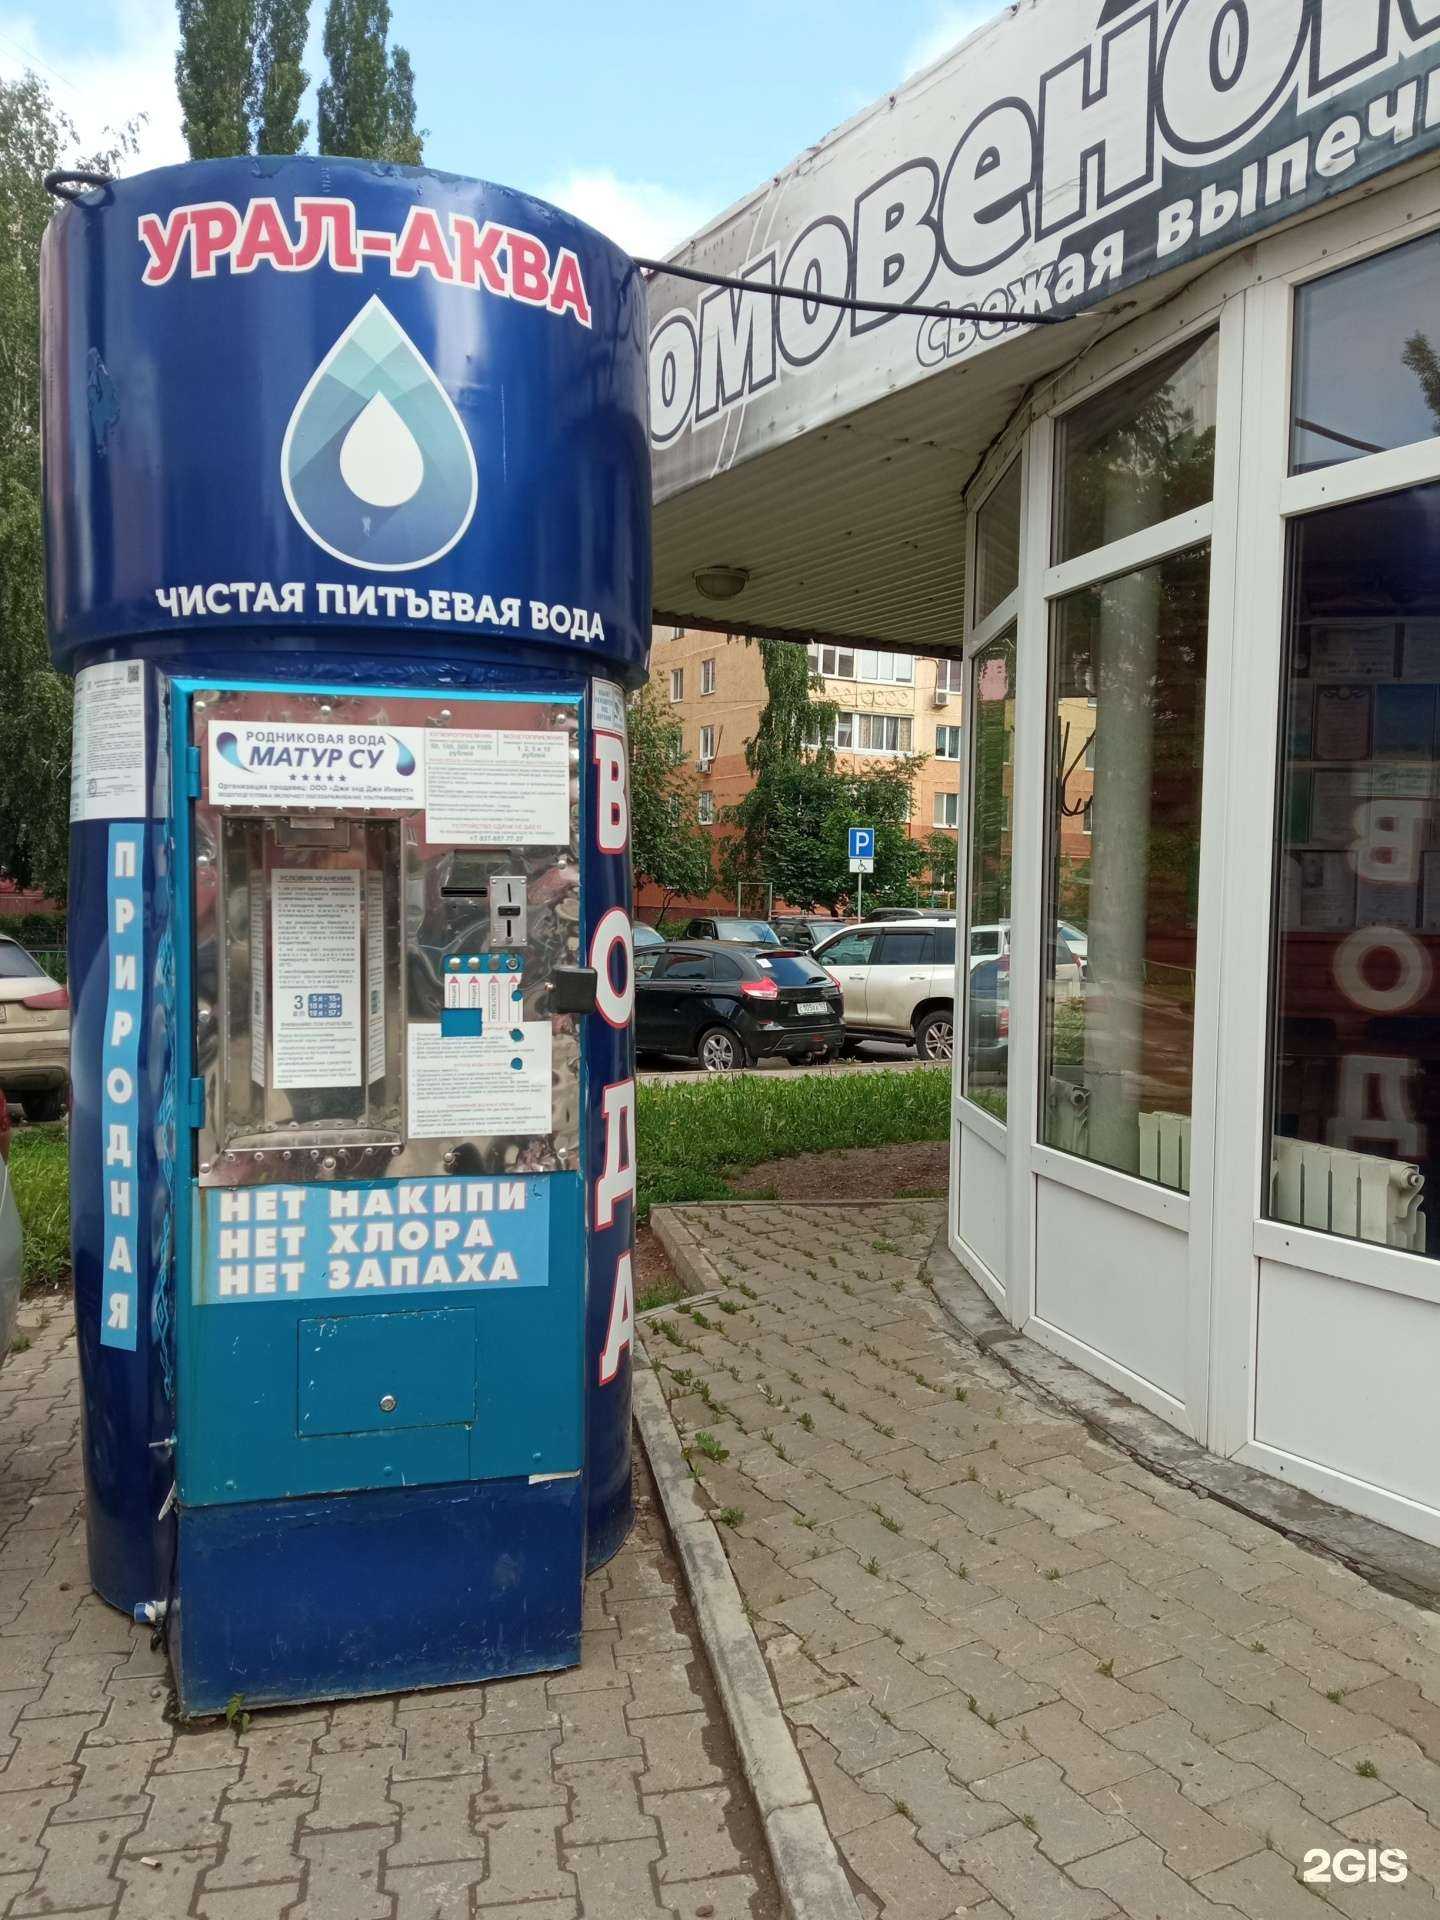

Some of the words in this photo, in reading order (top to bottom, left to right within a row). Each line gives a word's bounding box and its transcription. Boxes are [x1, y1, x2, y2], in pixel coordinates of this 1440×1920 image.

[138, 196, 593, 329] УРАЛ-АКВА
[155, 582, 305, 617] ЧИСТАЯ
[316, 583, 521, 627] ПИТЬЕВАЯ
[529, 601, 605, 642] ВОДА
[246, 731, 344, 744] РОДНИКОВАЯ
[349, 734, 386, 745] ВОДА
[249, 747, 343, 768] МАТУР
[349, 749, 384, 769] СУ
[856, 832, 870, 855] P
[294, 995, 304, 1010] 3
[589, 731, 636, 1384] ВОДА
[106, 841, 135, 1329] ПРИРОДНАЯ
[220, 1190, 306, 1222] НЕТ
[329, 1182, 526, 1218] НАКИПИ
[219, 1227, 306, 1259] НЕТ
[328, 1219, 494, 1254] ХЛОРА
[218, 1262, 305, 1296] НЕТ
[328, 1252, 518, 1290] ЗАПАХА
